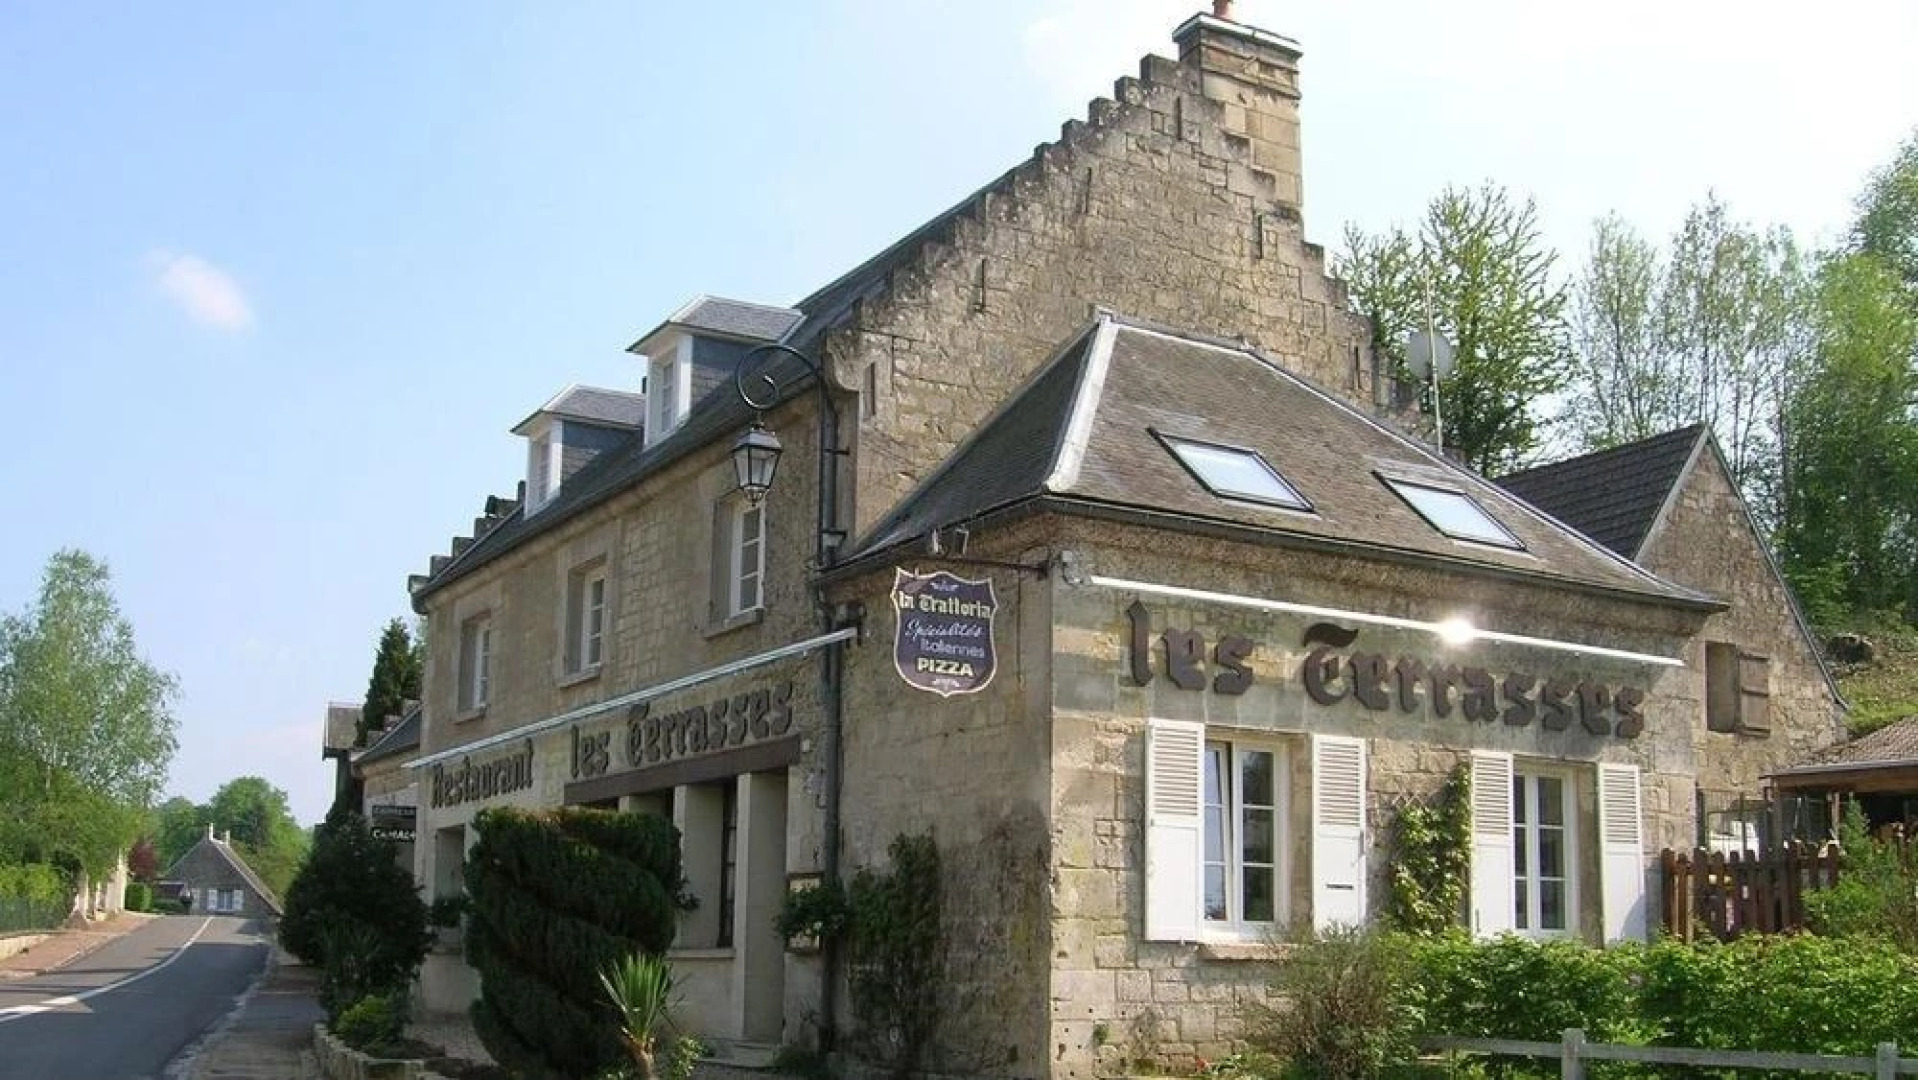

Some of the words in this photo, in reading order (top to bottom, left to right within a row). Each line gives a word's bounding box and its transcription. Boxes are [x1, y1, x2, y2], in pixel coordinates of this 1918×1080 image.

[919, 594, 991, 619] Trattoria
[917, 657, 974, 676] PIZZA
[1125, 600, 1254, 695] les
[1301, 622, 1645, 739] Terrasses
[430, 738, 534, 810] Restaurant
[570, 723, 611, 780] les
[625, 682, 793, 767] Terrasses
